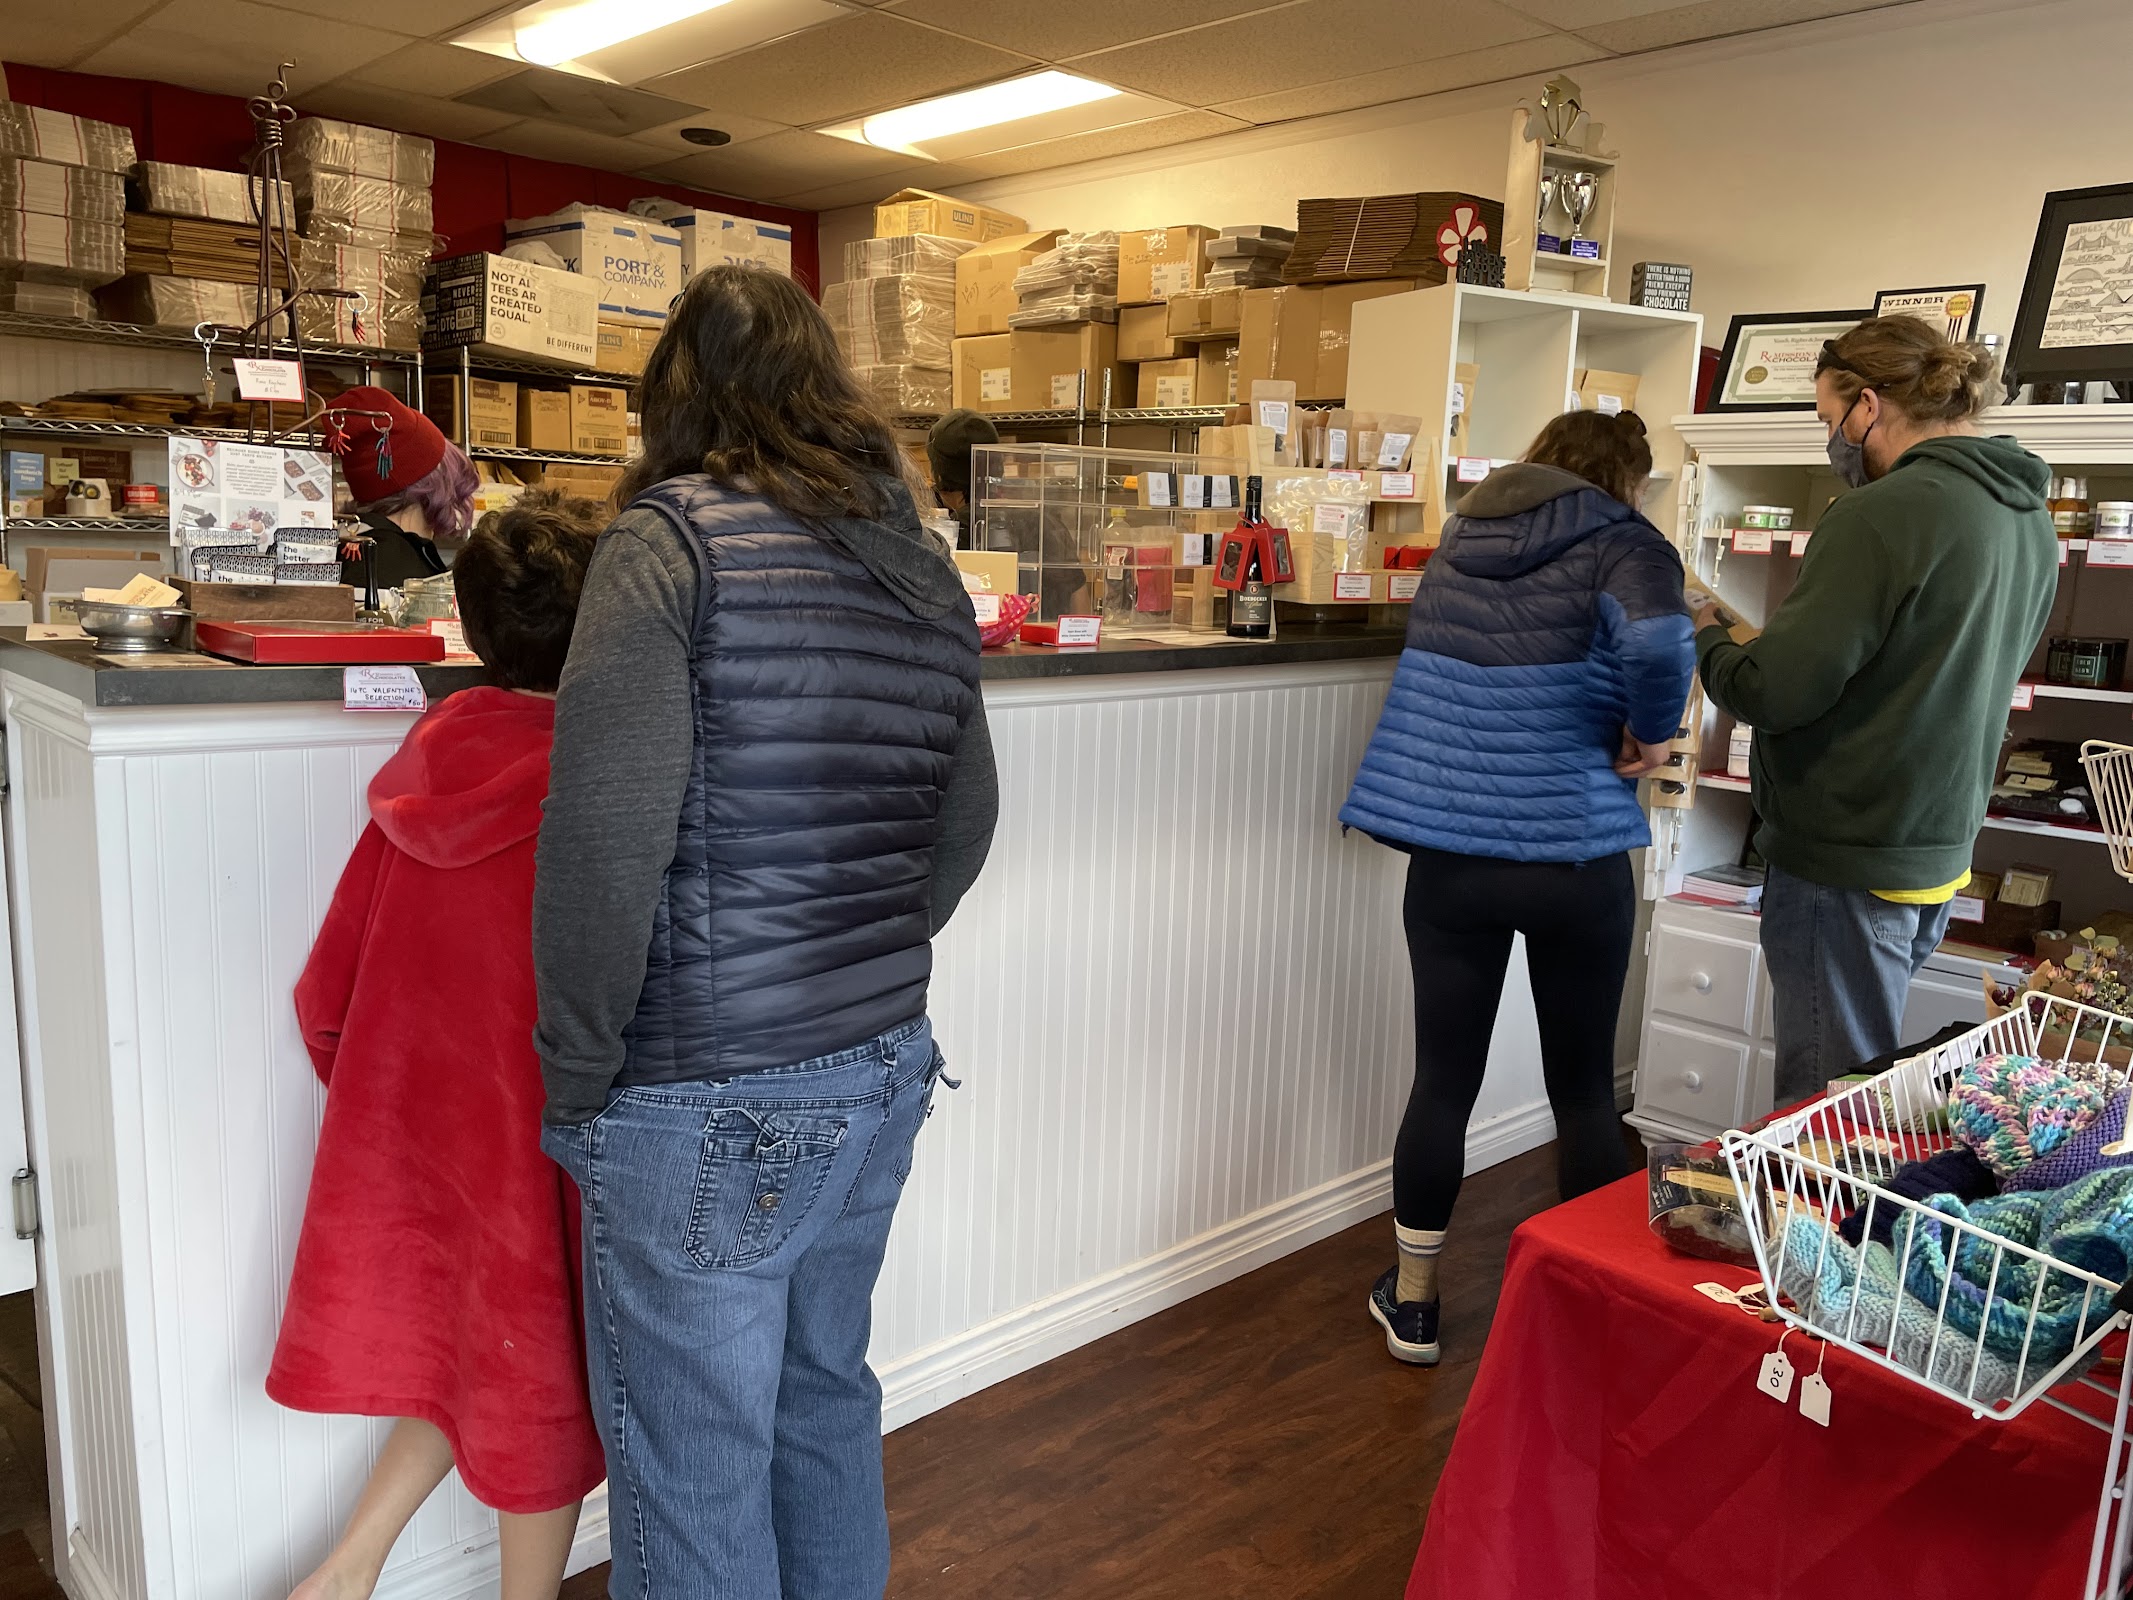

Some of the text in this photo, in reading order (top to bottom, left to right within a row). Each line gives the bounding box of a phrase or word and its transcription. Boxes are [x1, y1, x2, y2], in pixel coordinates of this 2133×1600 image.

[953, 210, 974, 225] ULINE
[604, 255, 650, 275] PORT
[653, 263, 665, 278] &
[1647, 265, 1690, 275] THERE IS NOTHING
[491, 270, 531, 288] NOT AL
[604, 271, 666, 289] COMPANY
[1645, 280, 1664, 288] FRIEND
[1665, 282, 1684, 290] EXCEPT
[1646, 272, 1662, 280] BETTER
[1663, 273, 1675, 282] THAN
[1679, 275, 1690, 283] GOOD
[453, 285, 475, 299] NEVER
[491, 283, 537, 301] TEES AR
[1645, 288, 1657, 296] GOOD
[1658, 289, 1675, 298] FRIEND
[490, 294, 542, 314] CREATED
[1644, 295, 1688, 310] CHOCOLATE
[1882, 296, 1944, 307] WINNER
[441, 315, 455, 332] DTG
[490, 307, 531, 325] EQUAL.
[546, 336, 592, 354] BE DIFFERENT
[283, 554, 310, 563] better
[218, 575, 233, 583] the
[1770, 1368, 1784, 1388] 30
